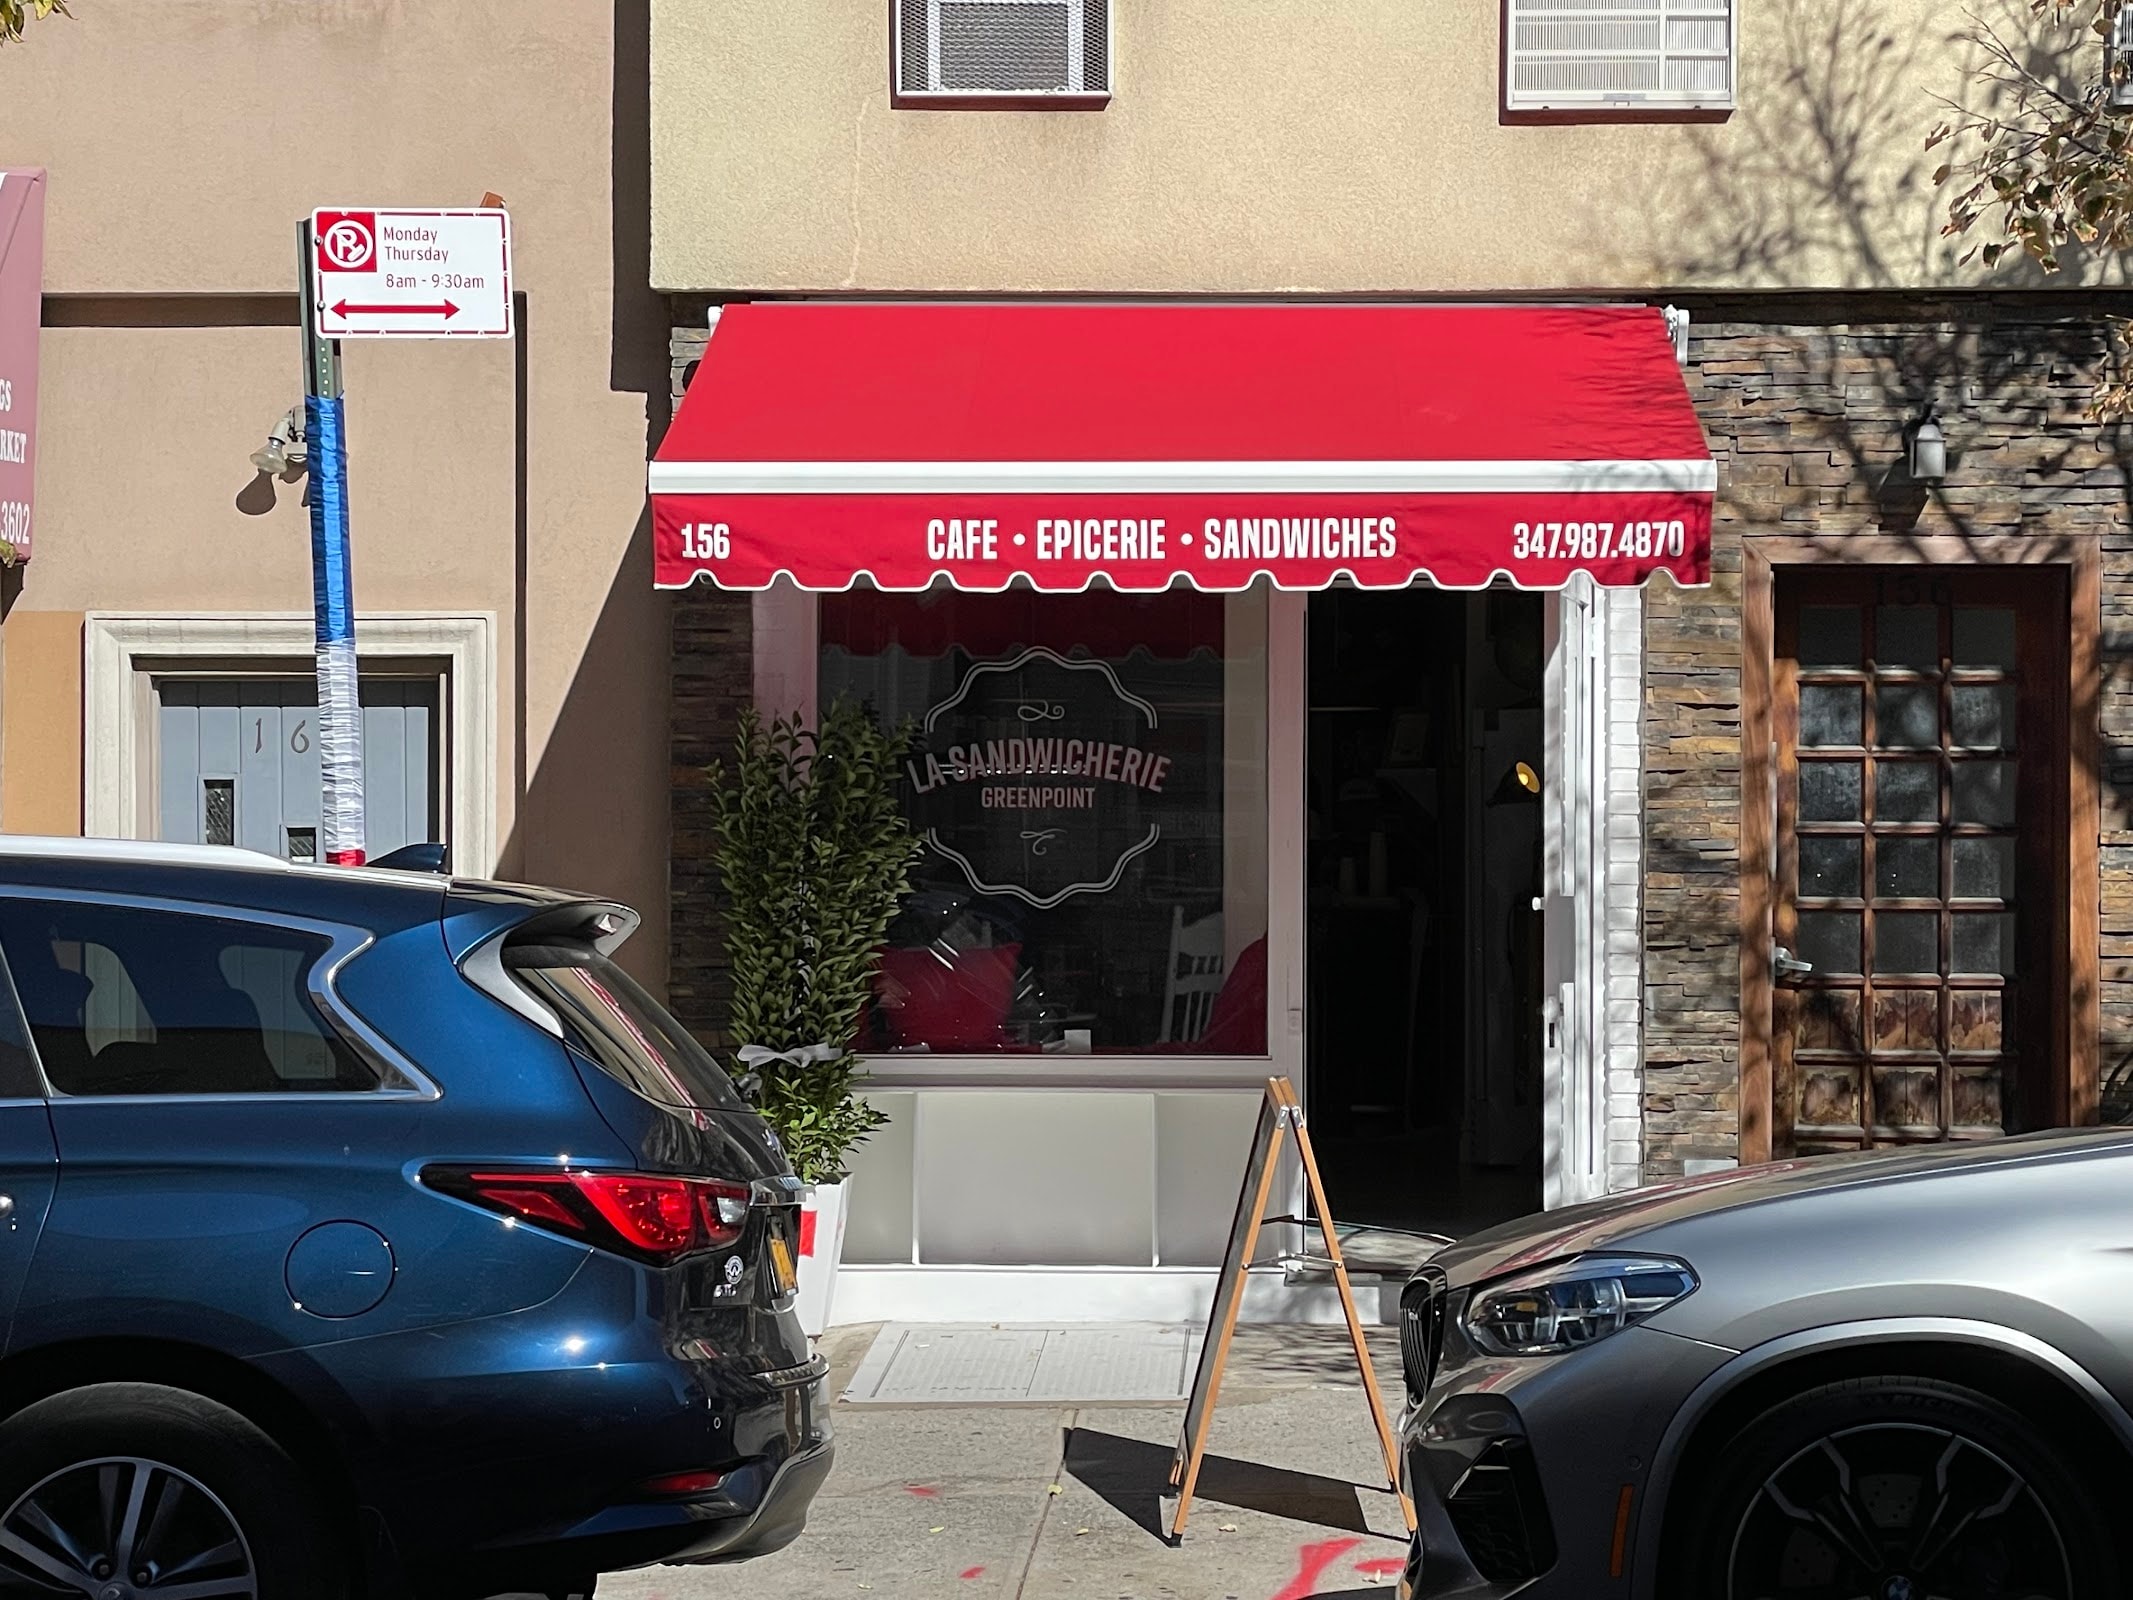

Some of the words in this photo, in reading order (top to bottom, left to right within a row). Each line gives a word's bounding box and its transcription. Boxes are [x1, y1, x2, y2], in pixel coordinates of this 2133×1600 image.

[383, 226, 438, 244] Monday
[384, 246, 449, 264] Thursday
[386, 273, 417, 289] 8am
[431, 273, 485, 289] 9:30am
[0, 429, 27, 464] RKET
[680, 523, 731, 560] 156
[927, 518, 998, 561] CAFE
[1036, 518, 1166, 561] EPICERIE
[1204, 516, 1397, 560] SANDWICHES
[1513, 520, 1685, 560] 347.987.4870
[253, 718, 310, 753] 16
[906, 753, 947, 794] LA
[948, 738, 1172, 793] SANDWICHERIE
[981, 786, 1096, 809] GREENPOINT
